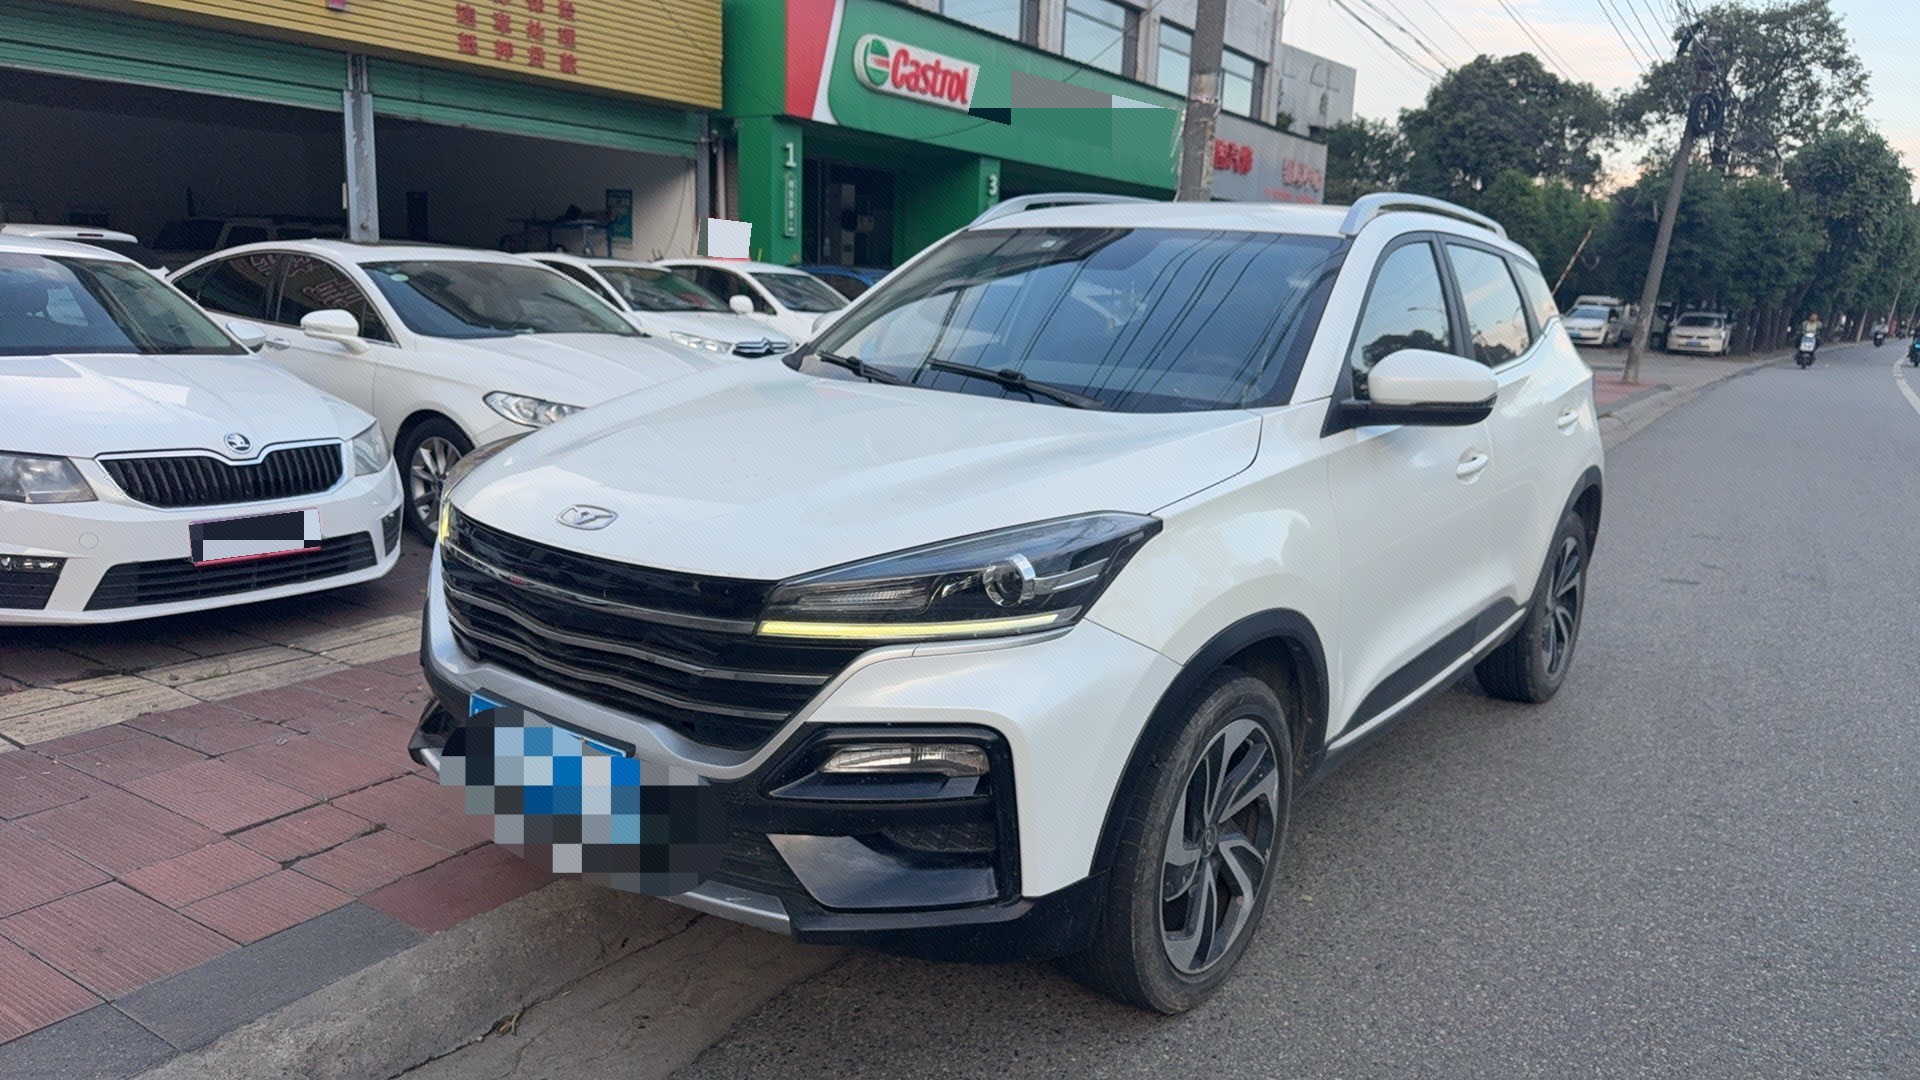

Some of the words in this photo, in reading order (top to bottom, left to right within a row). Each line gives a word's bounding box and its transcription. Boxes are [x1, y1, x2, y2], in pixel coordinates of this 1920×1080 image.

[891, 48, 969, 104] Castrol
[785, 142, 797, 168] 1
[989, 176, 998, 195] 3
